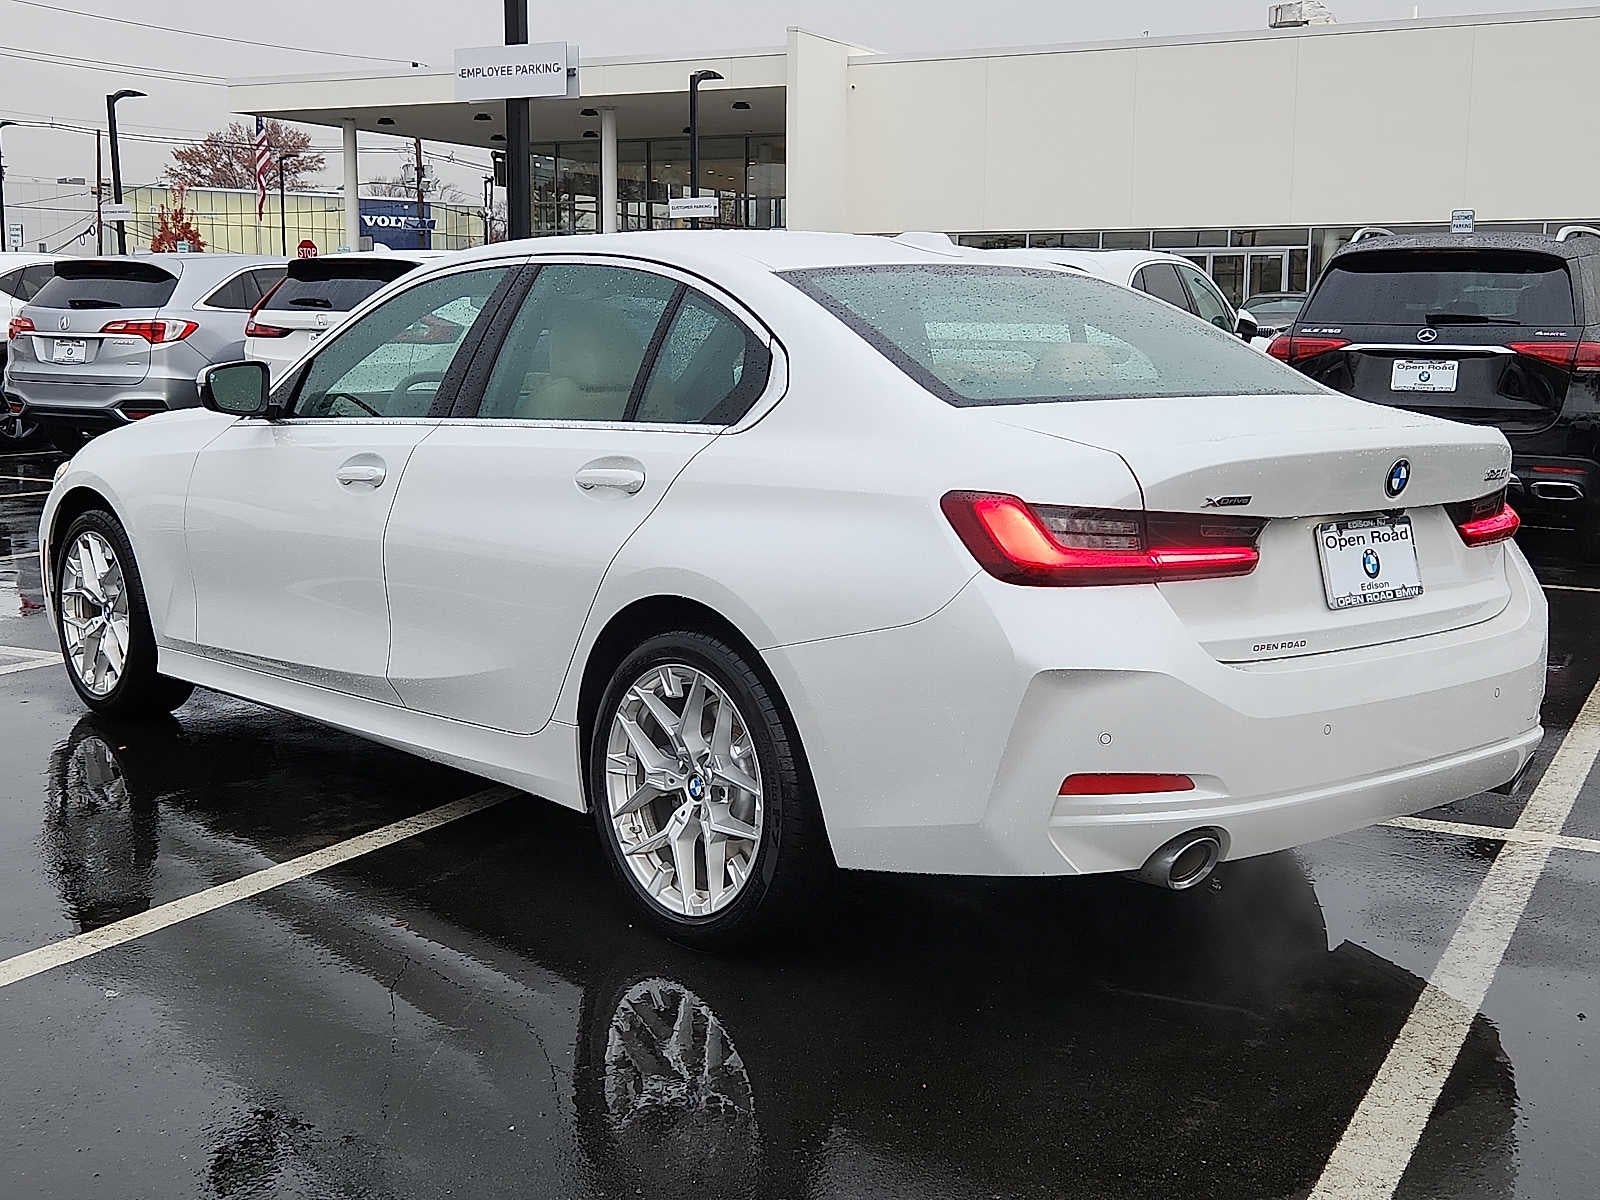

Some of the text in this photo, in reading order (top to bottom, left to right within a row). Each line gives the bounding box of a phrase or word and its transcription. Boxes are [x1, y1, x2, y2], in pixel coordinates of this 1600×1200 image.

[461, 63, 560, 78] EMPLOYEE PARKING
[298, 247, 317, 258] STOP
[1325, 527, 1409, 551] Open Road
[1360, 581, 1390, 591] Edison
[1337, 586, 1421, 607] OPEN ROAD BMW
[1252, 640, 1307, 652] OPEN ROAD
